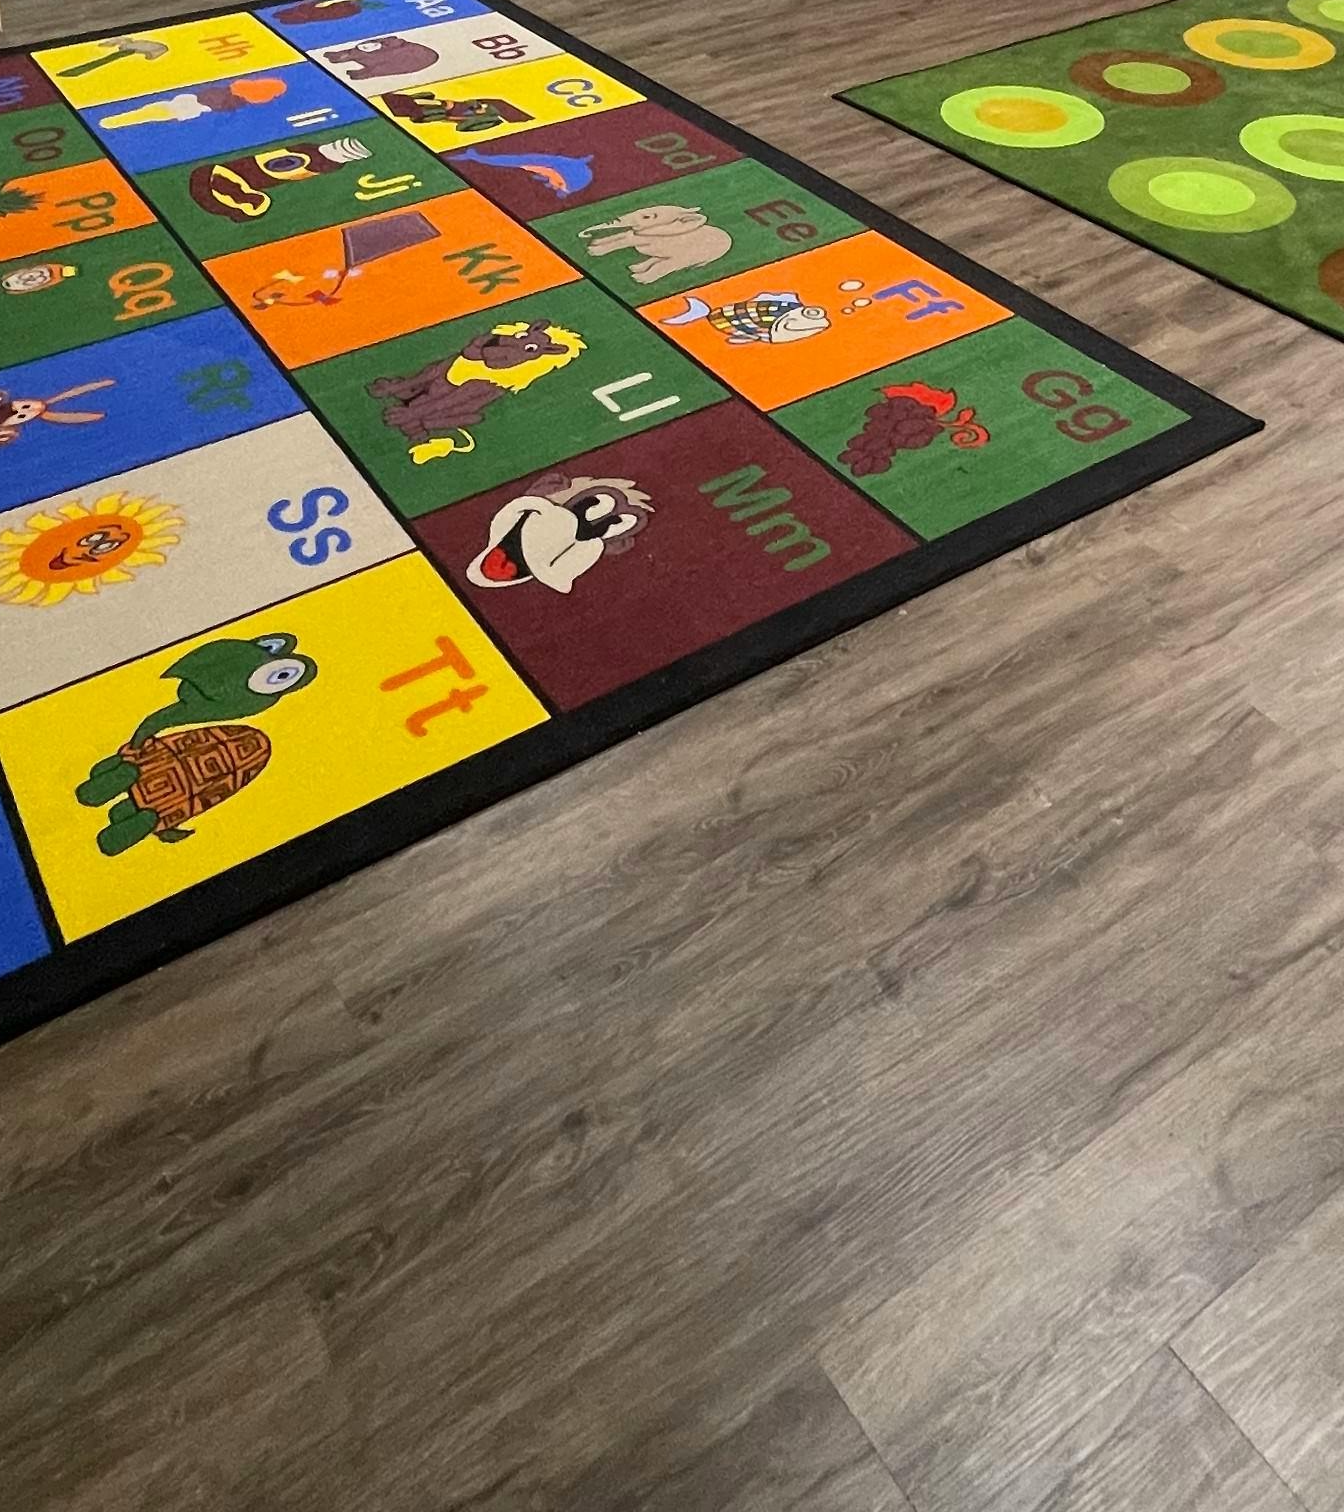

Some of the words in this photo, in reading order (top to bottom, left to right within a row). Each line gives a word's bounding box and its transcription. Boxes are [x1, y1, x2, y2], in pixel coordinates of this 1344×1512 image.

[197, 31, 250, 62] Hh
[471, 33, 527, 63] Bb
[285, 106, 340, 129] Ii
[545, 77, 603, 109] Cc
[12, 124, 67, 163] Oo
[633, 132, 718, 173] Dd
[353, 172, 423, 201] Jj
[53, 190, 118, 235] Pp
[741, 196, 820, 245] Ee
[107, 261, 178, 323] Qq
[442, 242, 525, 296] Kk
[872, 277, 969, 327] Ff
[590, 369, 684, 425] Ll
[1019, 368, 1134, 446] Gg
[266, 485, 353, 569] Ss
[696, 463, 835, 574] Mm
[378, 634, 490, 739] Tt
